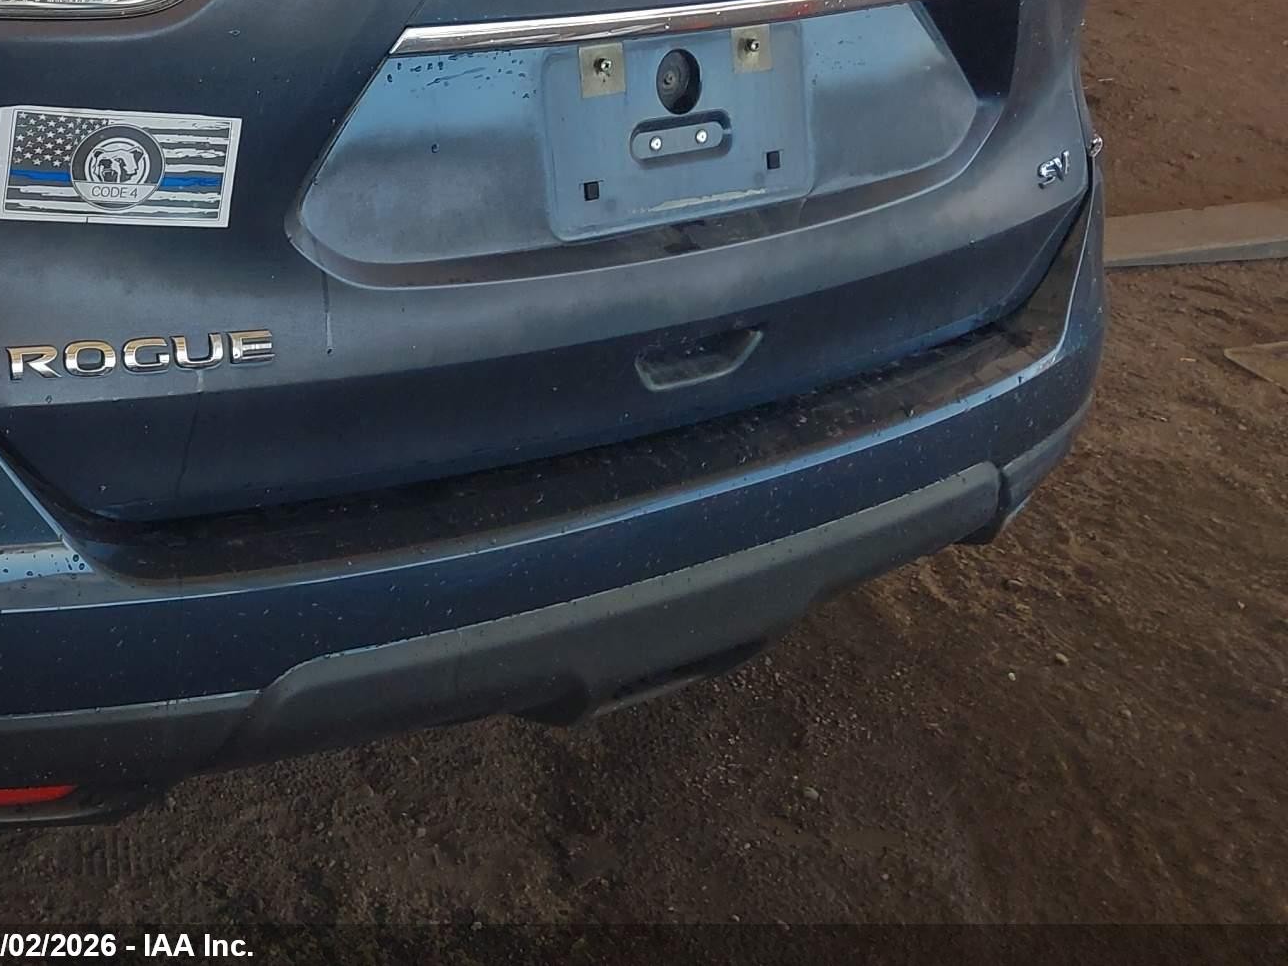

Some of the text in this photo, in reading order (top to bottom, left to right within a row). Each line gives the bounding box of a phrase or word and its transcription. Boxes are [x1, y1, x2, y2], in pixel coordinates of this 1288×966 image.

[1037, 149, 1071, 189] SV
[91, 185, 138, 199] CODE 4
[5, 329, 276, 381] ROGUE
